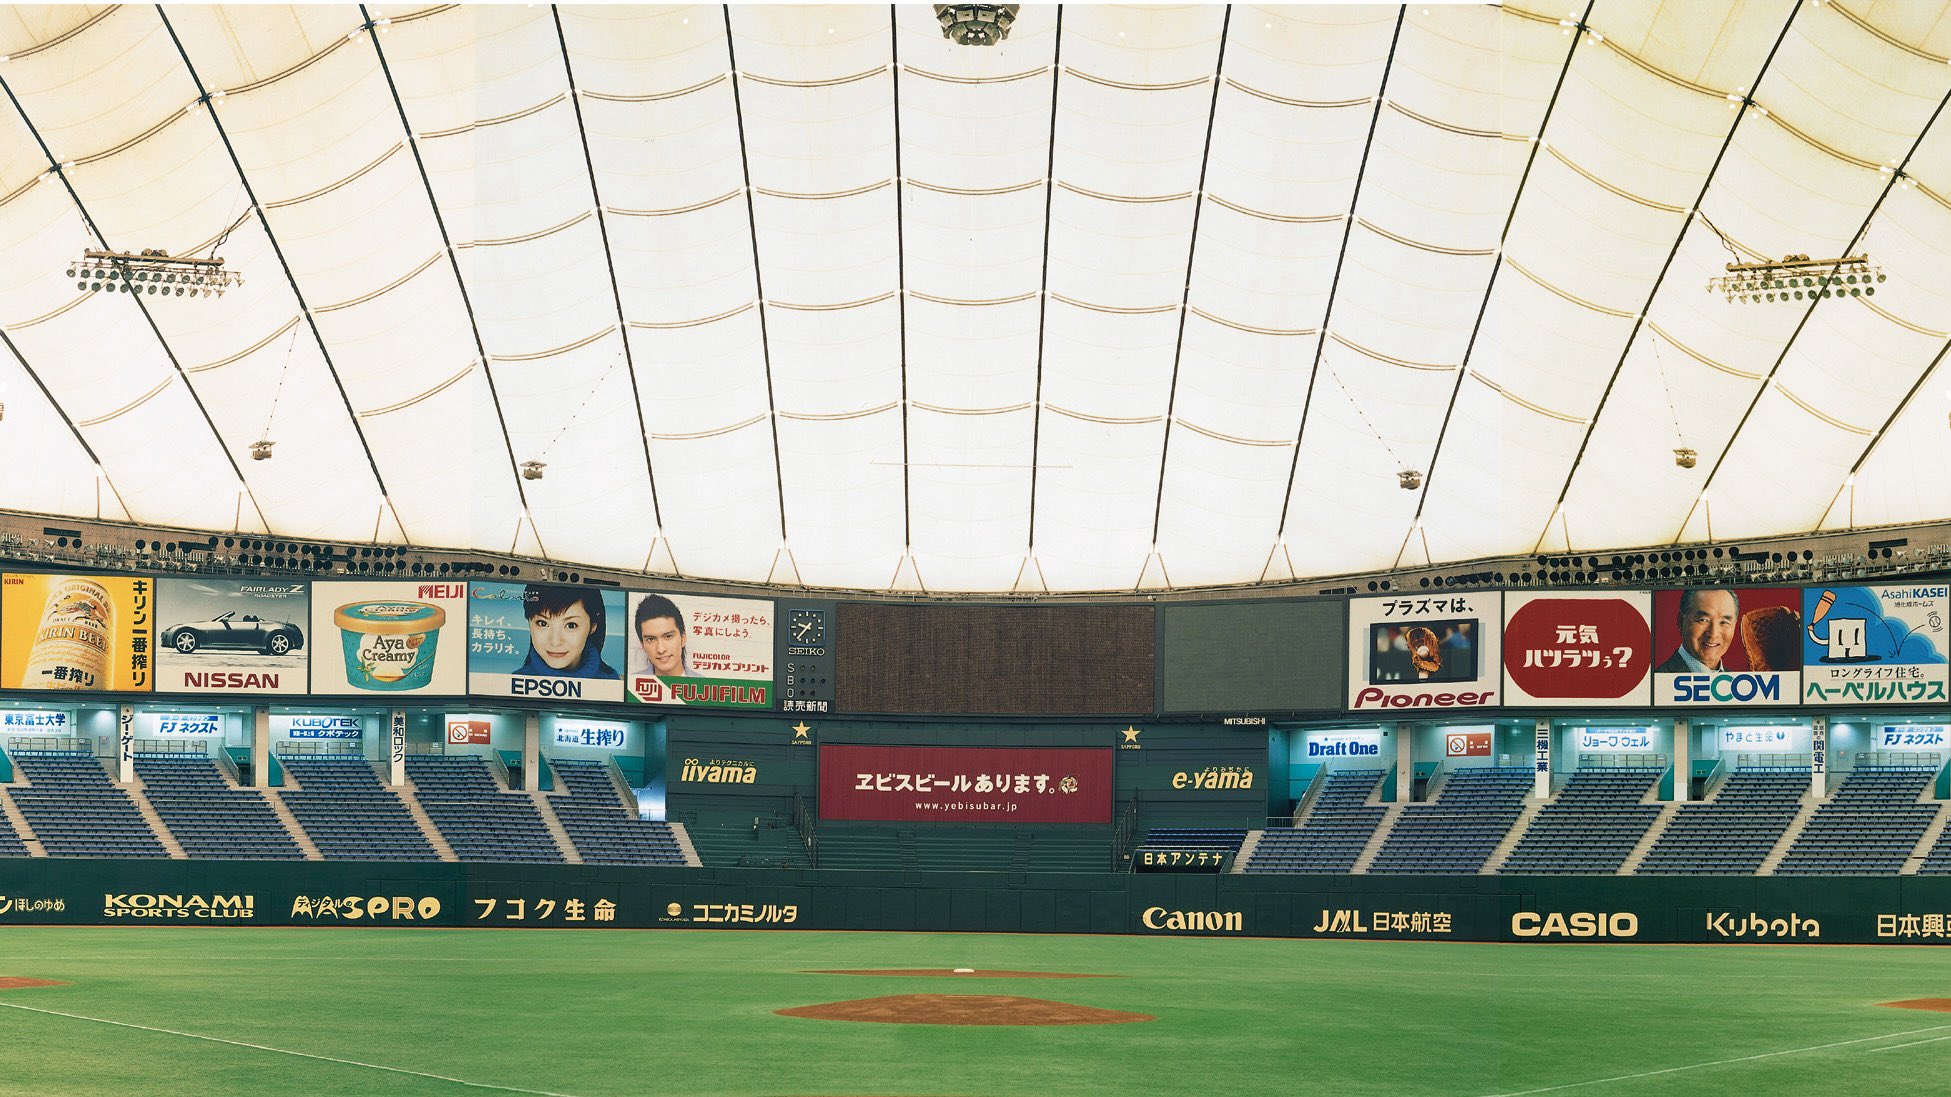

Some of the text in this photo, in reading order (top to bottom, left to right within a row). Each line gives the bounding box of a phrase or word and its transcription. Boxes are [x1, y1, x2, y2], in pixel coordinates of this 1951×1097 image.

[289, 584, 305, 593] Z
[418, 584, 464, 599] MEIJI
[1382, 598, 1474, 616] プラズマは、
[472, 615, 511, 627] キレイ、
[693, 612, 770, 626] デジカメ撮ったら、
[132, 580, 148, 687] キリン一番搾り
[471, 628, 512, 641] 長持ち、
[1555, 624, 1599, 644] 元気
[373, 635, 404, 653] Aya
[471, 642, 520, 655] カラリオ。
[788, 647, 826, 656] SEIKO
[362, 649, 416, 664] Creamy
[693, 653, 731, 661] FUJICOLOR
[693, 661, 769, 673] デジカメプリント
[787, 663, 795, 673] S
[1830, 667, 1925, 679] ロングライフ住宅。
[41, 666, 95, 687] 一番搾り
[184, 672, 279, 689] NISSAN
[787, 675, 795, 686] B
[511, 678, 582, 698] EPSON
[671, 684, 766, 704] FUJIFILM
[1673, 674, 1780, 702] SECOM
[1806, 681, 1947, 702] ヘーベルハウス
[1354, 687, 1495, 708] Pioneer
[783, 699, 828, 713] 読売新聞
[4, 713, 66, 726] 東京富士大学
[292, 717, 359, 729] KUBOTEK
[1223, 717, 1266, 725] MITSUBISHI
[160, 722, 218, 734] FJ ネクスト
[393, 716, 404, 763] 美和ロック
[556, 728, 625, 747] 北海道 生搾り
[1884, 733, 1944, 746] FJ ネクスト
[1308, 741, 1379, 756] Draft One
[1536, 729, 1549, 773] 三機工業
[681, 758, 757, 784] iiyama
[1172, 772, 1254, 789] e-yama
[915, 801, 1018, 812] www.yebisubar.jp
[1144, 852, 1223, 866] 日本アンテナ
[15, 898, 66, 912] ほしのゆめ
[104, 893, 254, 909] KONAMI
[103, 908, 254, 918] SPORTS CLUB
[474, 898, 617, 922] フコク生命
[693, 903, 798, 923] コニカミノルタ
[1142, 906, 1243, 931] Canon
[1313, 909, 1368, 933] JAL
[1372, 911, 1452, 933] 日本航空
[1511, 911, 1639, 937] CASIO
[1706, 912, 1820, 937] Kubota
[1877, 913, 1951, 938] 日本興
